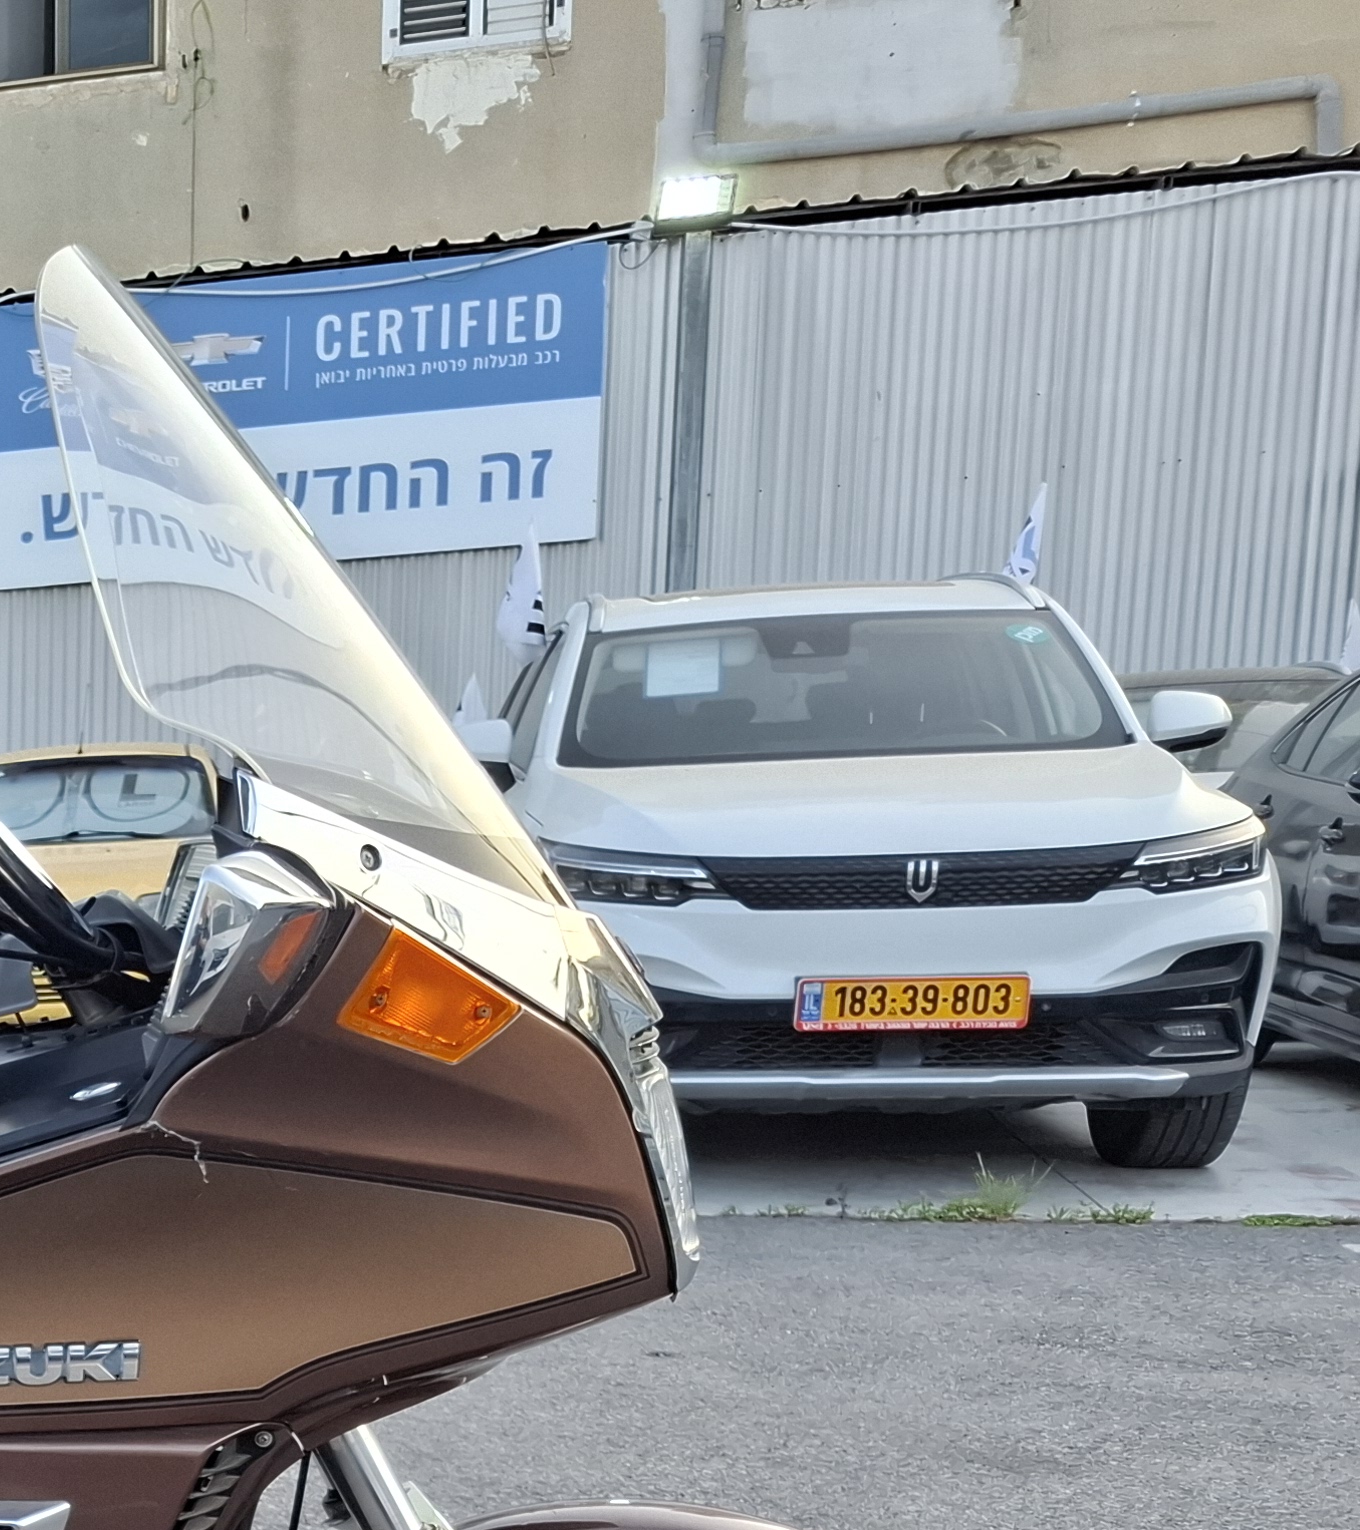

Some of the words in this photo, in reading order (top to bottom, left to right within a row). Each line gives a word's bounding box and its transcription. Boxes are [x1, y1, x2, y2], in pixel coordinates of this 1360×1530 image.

[315, 293, 562, 362] CERTIFIED
[472, 352, 528, 370] מבעלות
[534, 350, 560, 365] רכב
[355, 364, 416, 381] באחריות
[421, 359, 467, 375] פרטית
[202, 377, 266, 393] ROLET
[315, 370, 350, 389] יבואן
[479, 448, 553, 504] זה
